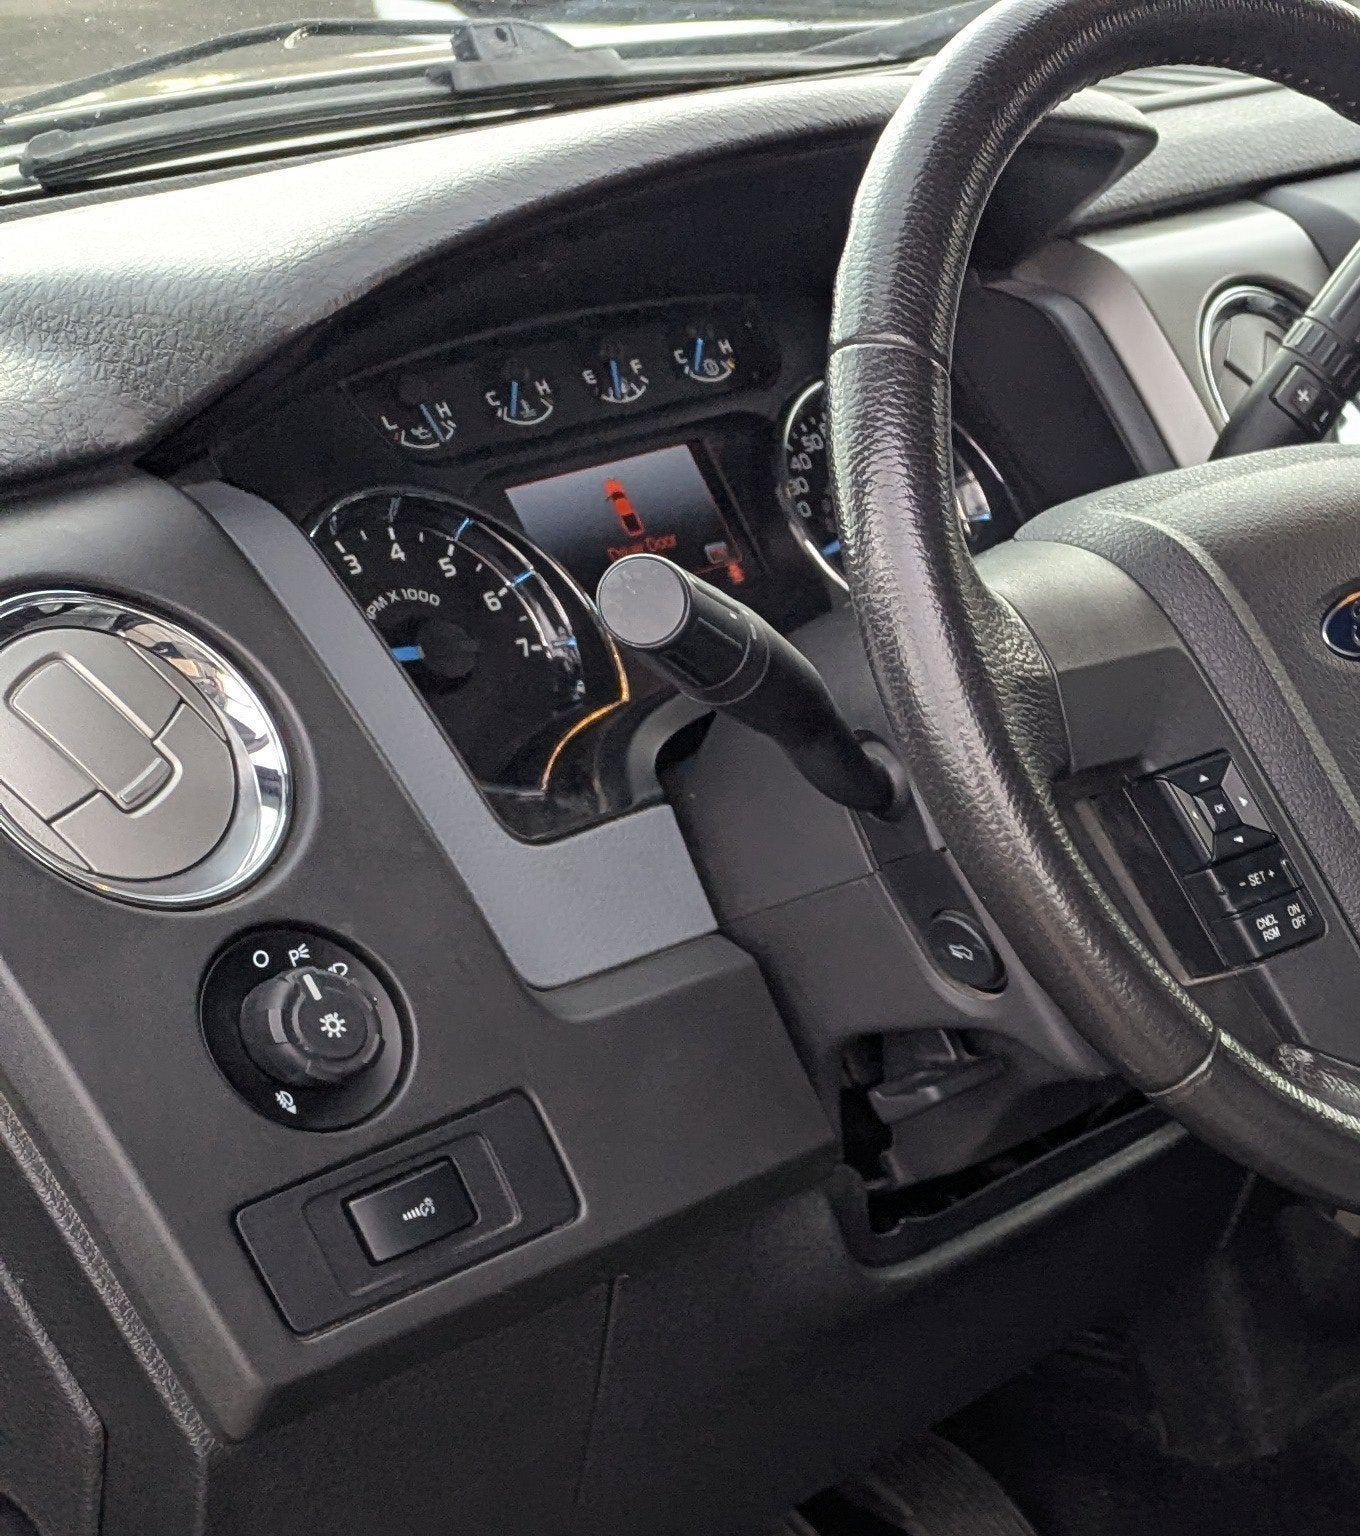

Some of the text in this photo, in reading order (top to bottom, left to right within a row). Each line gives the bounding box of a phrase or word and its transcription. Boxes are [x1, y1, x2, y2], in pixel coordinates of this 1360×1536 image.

[717, 338, 733, 355] H
[582, 358, 642, 385] E F
[535, 378, 551, 395] H
[381, 401, 452, 431] L H
[390, 541, 406, 562] 4
[343, 553, 363, 576] 3
[438, 556, 457, 578] 5
[365, 595, 389, 621] PM
[401, 587, 441, 607] 1000
[482, 590, 502, 612] 6
[515, 637, 530, 658] 7
[1248, 870, 1267, 887] SET
[1287, 903, 1301, 917] ON
[1256, 913, 1278, 931] CNCL
[1291, 915, 1307, 930] OFF
[1262, 927, 1281, 942] RSM
